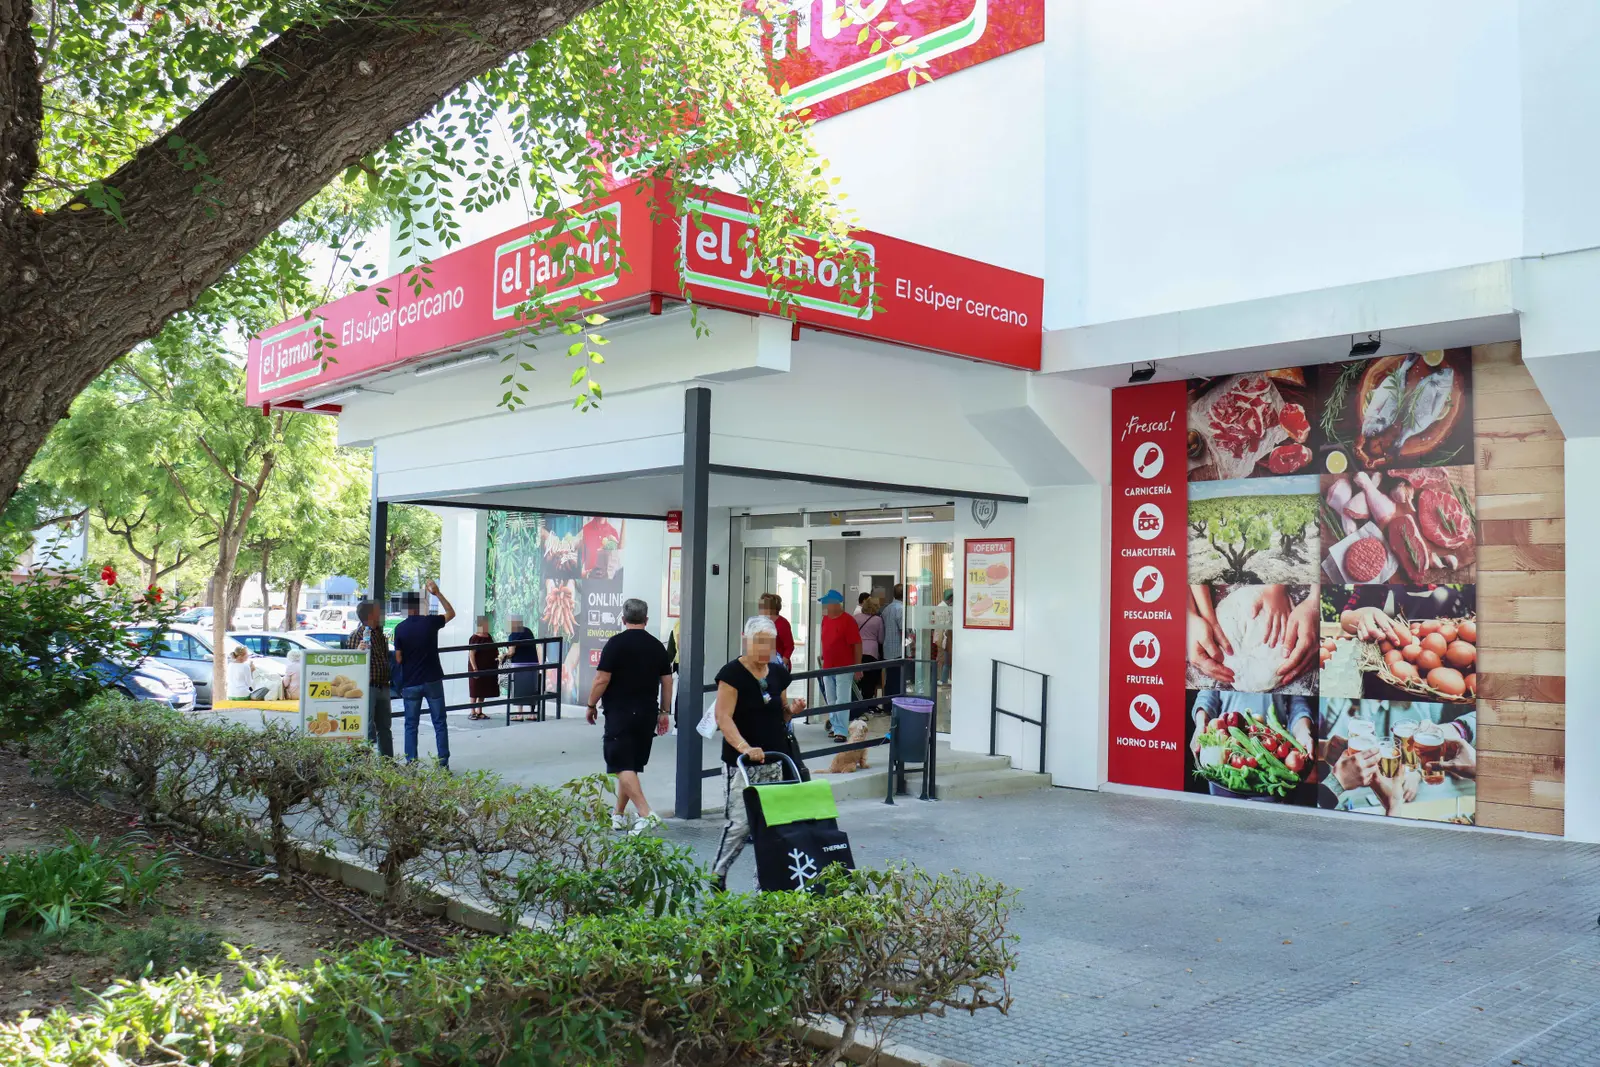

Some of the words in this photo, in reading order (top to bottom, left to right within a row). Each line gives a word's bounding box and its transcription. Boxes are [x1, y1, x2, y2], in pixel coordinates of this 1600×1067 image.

[695, 222, 732, 265] el
[500, 252, 523, 294] el
[895, 277, 911, 299] El
[914, 284, 963, 311] súper
[965, 299, 1028, 327] cercano
[341, 318, 354, 347] El
[355, 310, 397, 344] súper
[398, 286, 464, 327] cercano
[263, 345, 275, 375] el
[1121, 410, 1176, 442] ¡Frescos!
[1124, 484, 1172, 496] CARNICERÍA
[973, 543, 1006, 552] ¡OFERTA!
[1121, 546, 1176, 557] CHARCUTERÍA
[1124, 610, 1172, 620] PESCADERÍA
[314, 654, 358, 664] ¡OFERTA!
[1126, 674, 1164, 685] FRUTERÍA
[1117, 737, 1146, 748] HORNO
[1148, 739, 1158, 749] DE
[1161, 741, 1177, 751] PAN
